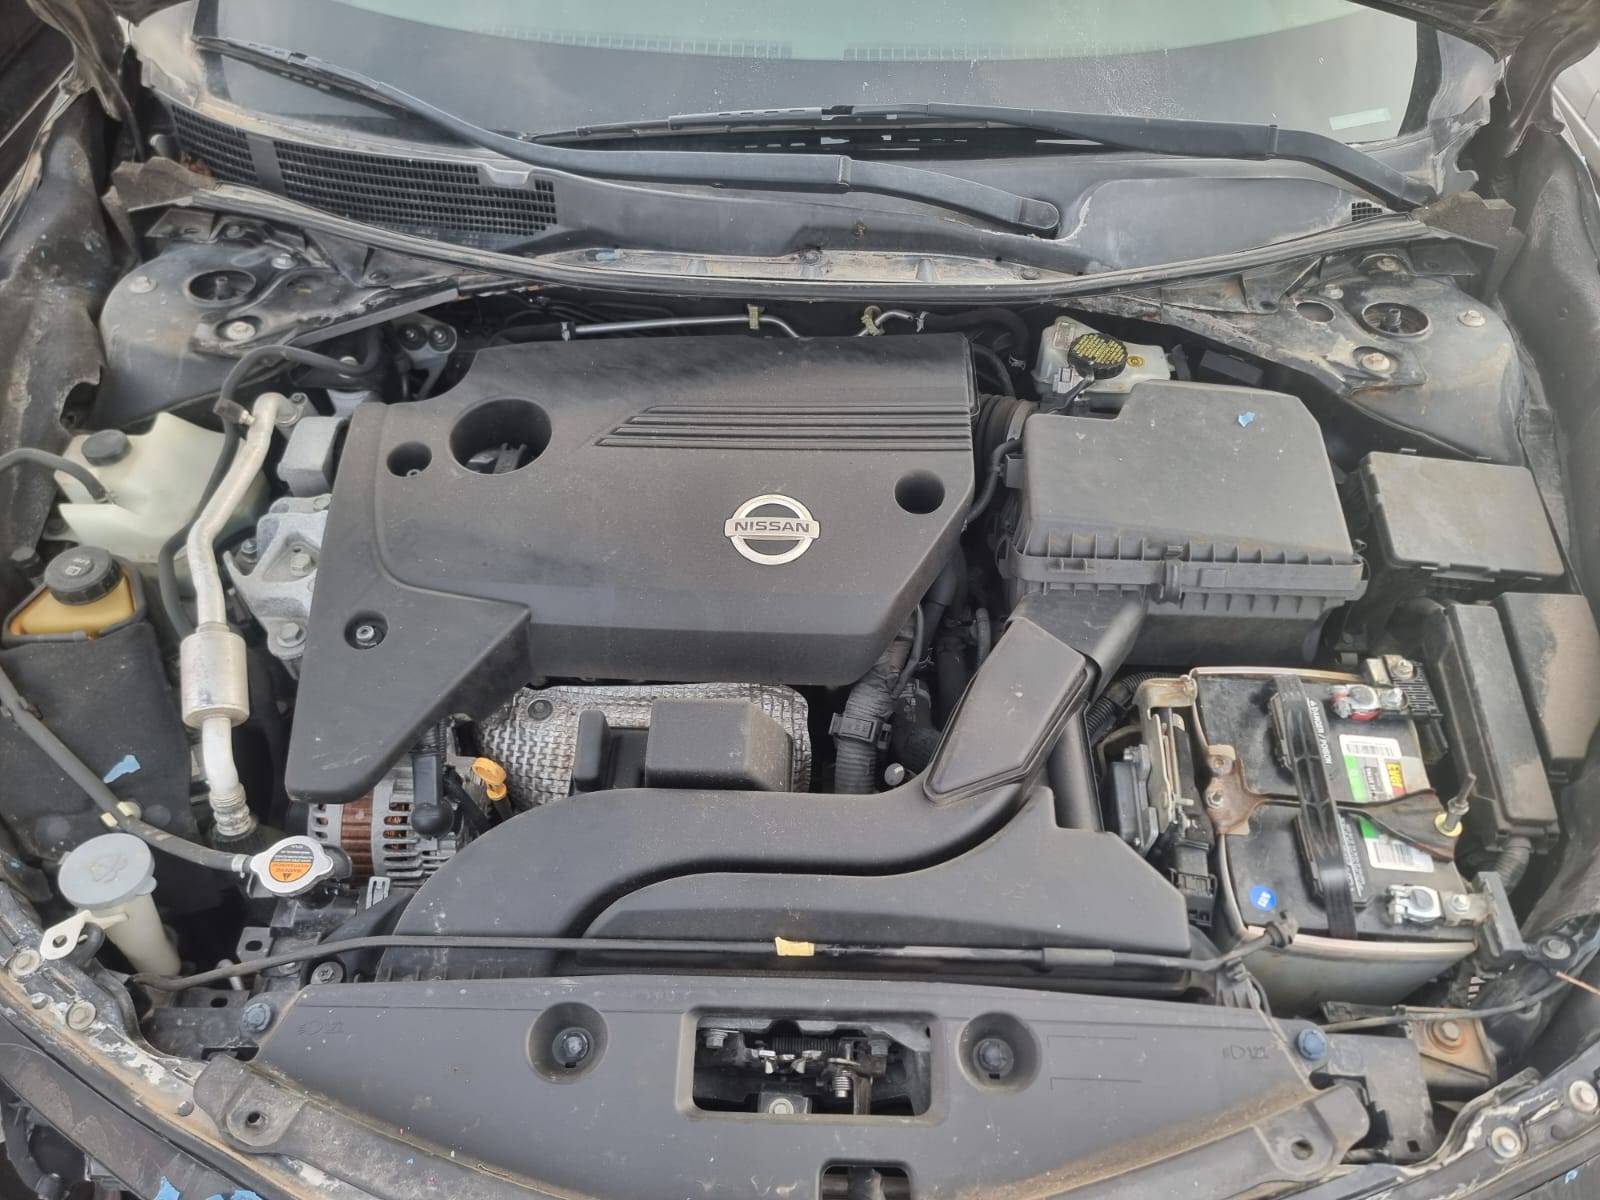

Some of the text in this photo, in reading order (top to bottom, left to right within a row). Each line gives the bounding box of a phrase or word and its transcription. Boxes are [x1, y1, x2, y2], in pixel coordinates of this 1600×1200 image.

[734, 521, 810, 533] NISSAN
[1311, 706, 1325, 733] DANGER
[1320, 740, 1333, 765] POISON
